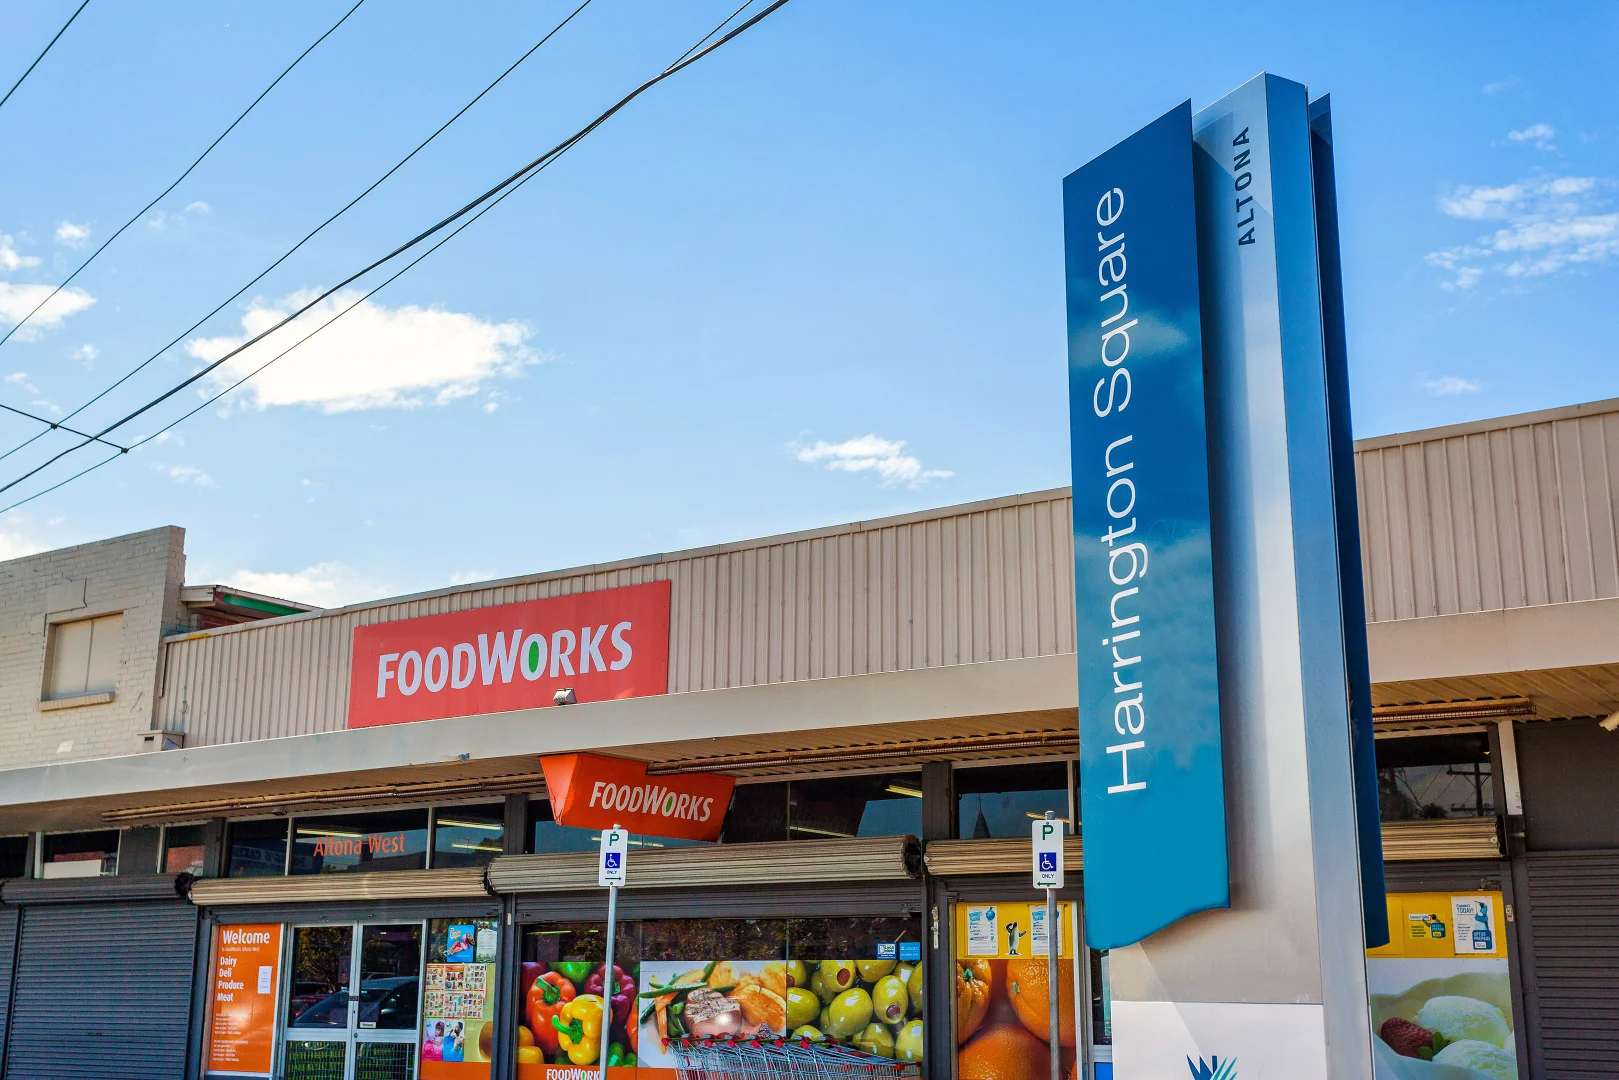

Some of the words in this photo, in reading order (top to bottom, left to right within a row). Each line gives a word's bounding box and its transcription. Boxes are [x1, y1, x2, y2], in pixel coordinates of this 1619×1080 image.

[1232, 126, 1256, 246] ALTONA
[1093, 187, 1138, 418] Square
[1100, 434, 1148, 794] Harrington
[376, 621, 633, 699] FOODWORKS
[588, 781, 714, 823] FOODWORKS
[609, 833, 620, 846] P
[1042, 824, 1054, 840] P
[313, 835, 362, 857] Altona
[367, 833, 405, 854] West
[222, 928, 271, 945] Welcome
[220, 956, 238, 967] Dairy
[219, 968, 232, 978] Deli
[218, 980, 244, 990] Produce
[216, 993, 234, 1002] Meat
[546, 1068, 601, 1080] FOODWORK
